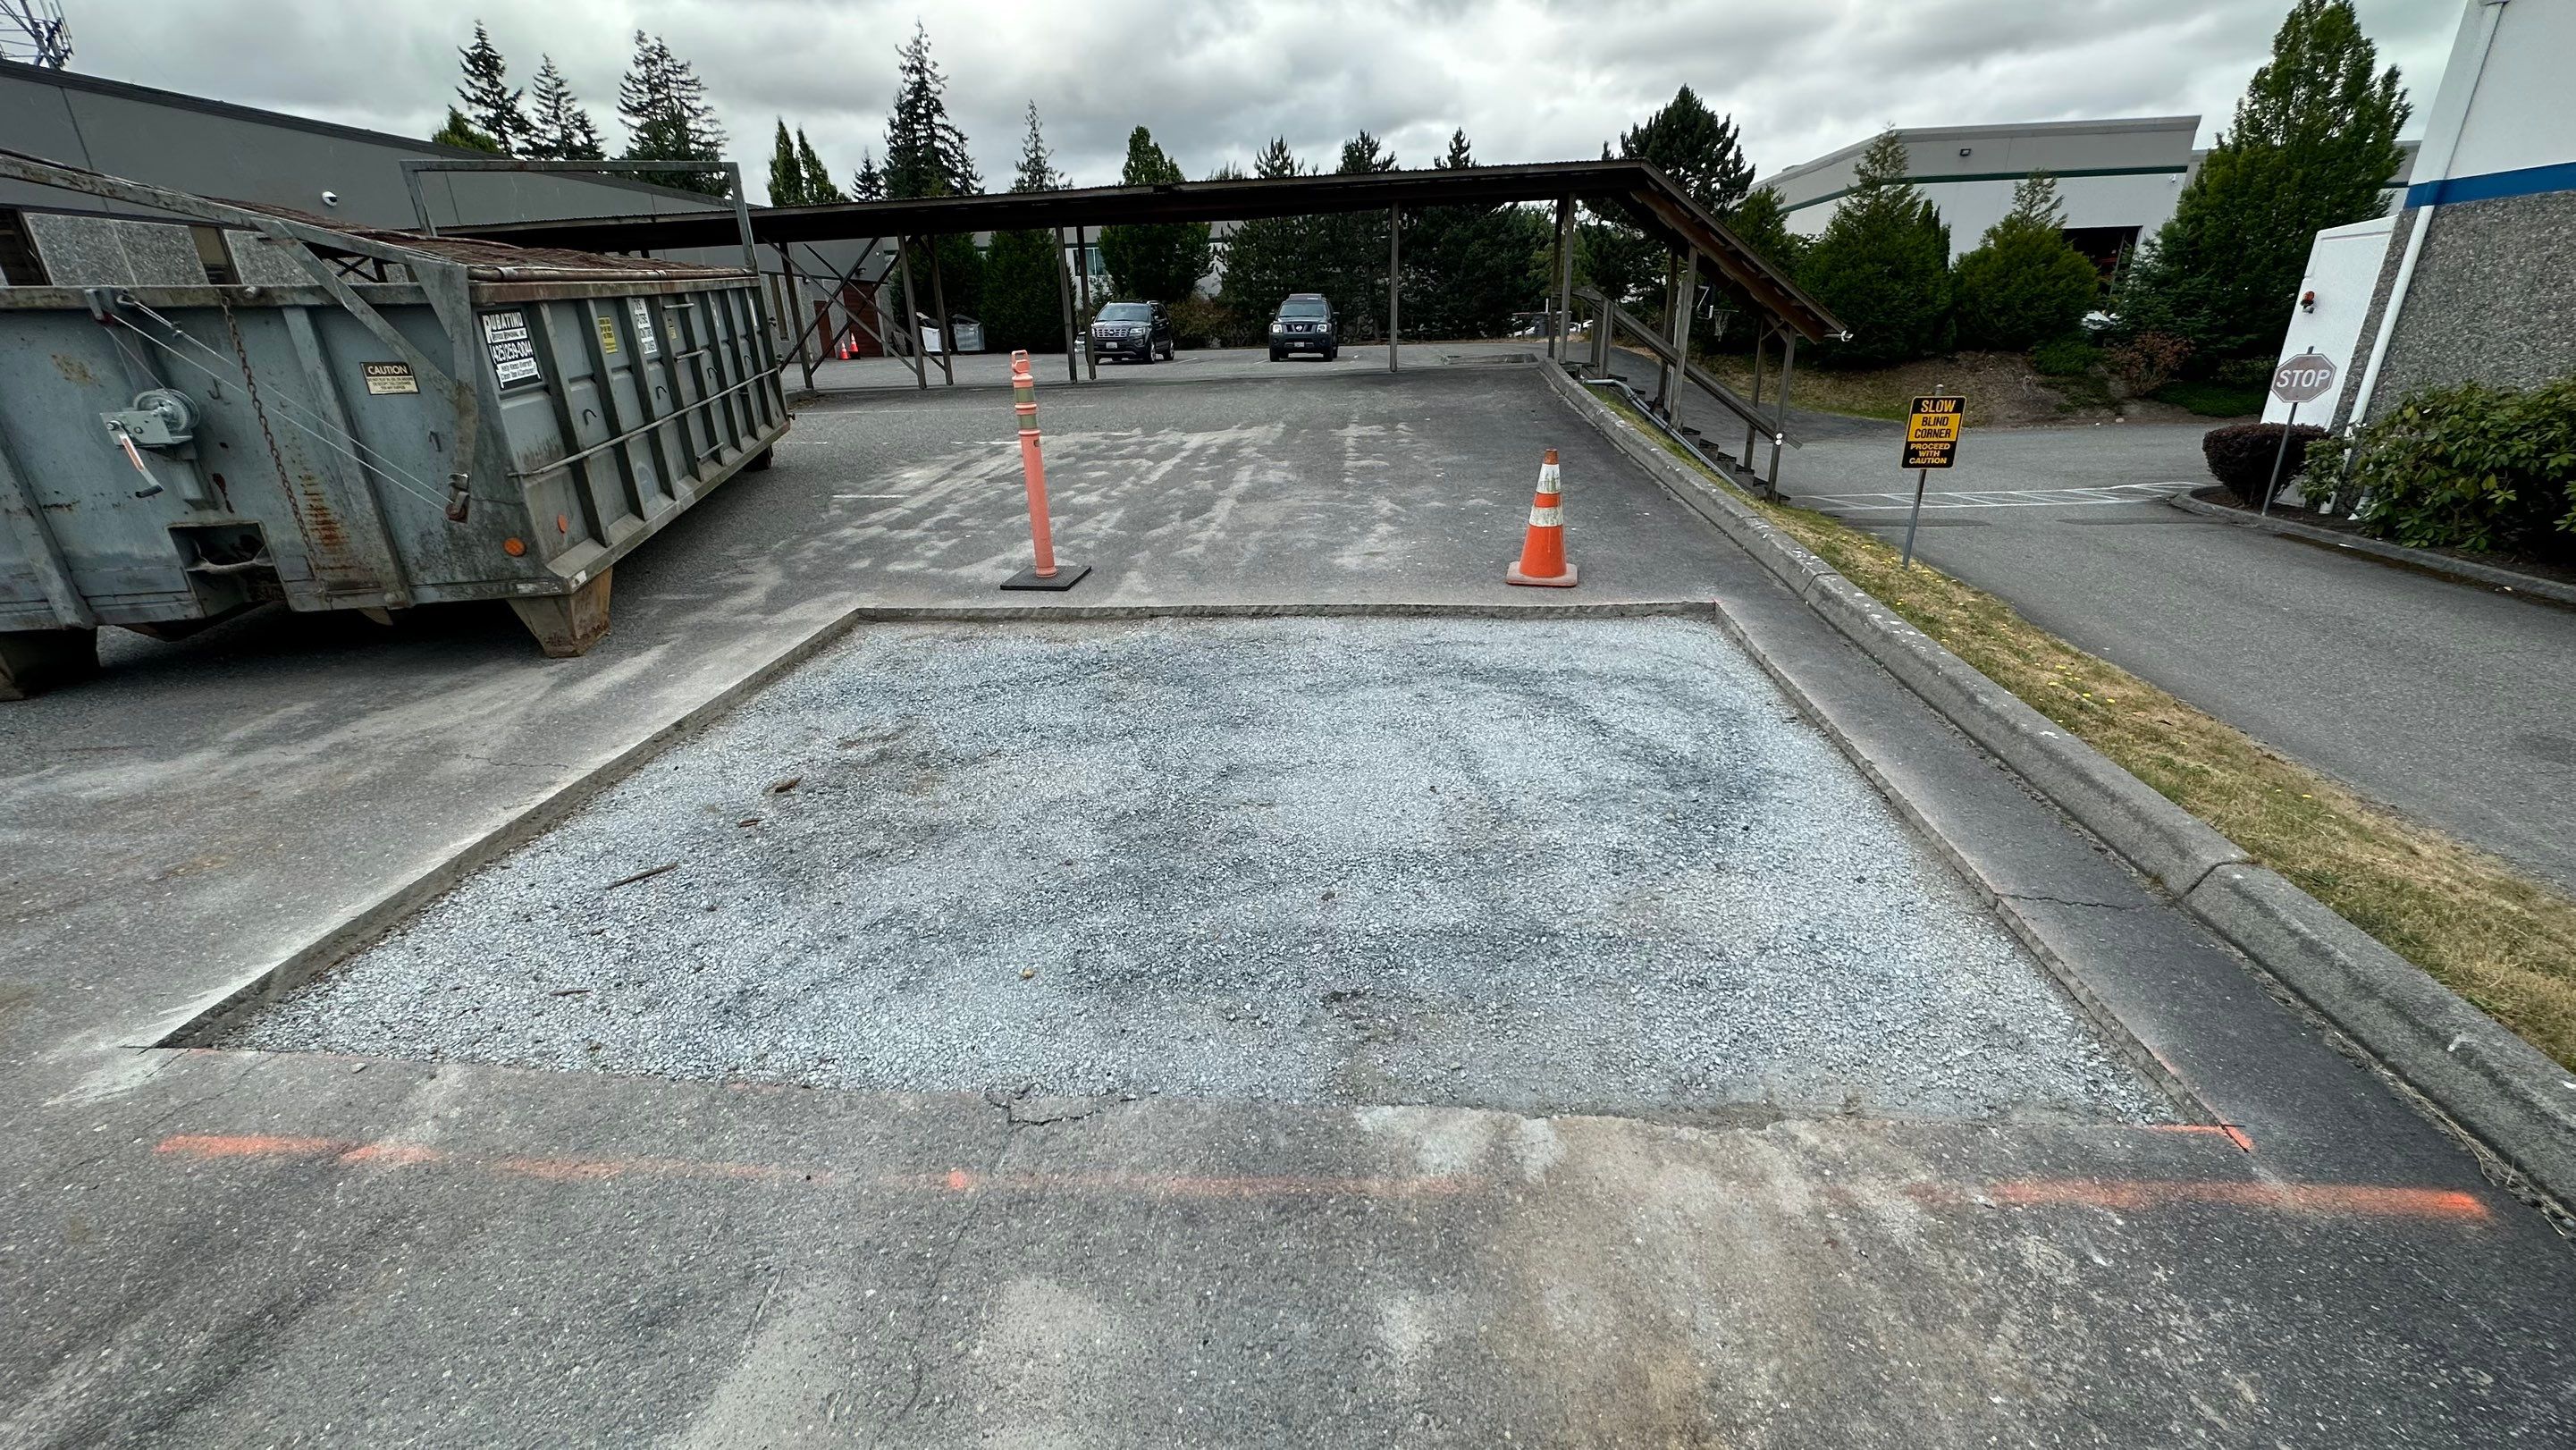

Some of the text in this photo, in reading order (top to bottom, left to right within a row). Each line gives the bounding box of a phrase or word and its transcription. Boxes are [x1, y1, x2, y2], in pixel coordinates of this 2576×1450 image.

[482, 312, 524, 343] RUBATINO
[367, 365, 408, 375] CAUTION
[2276, 369, 2331, 387] STOP
[1921, 400, 1956, 412] SLOW
[1921, 417, 1949, 426] BLIND
[1915, 429, 1951, 438] CORNER
